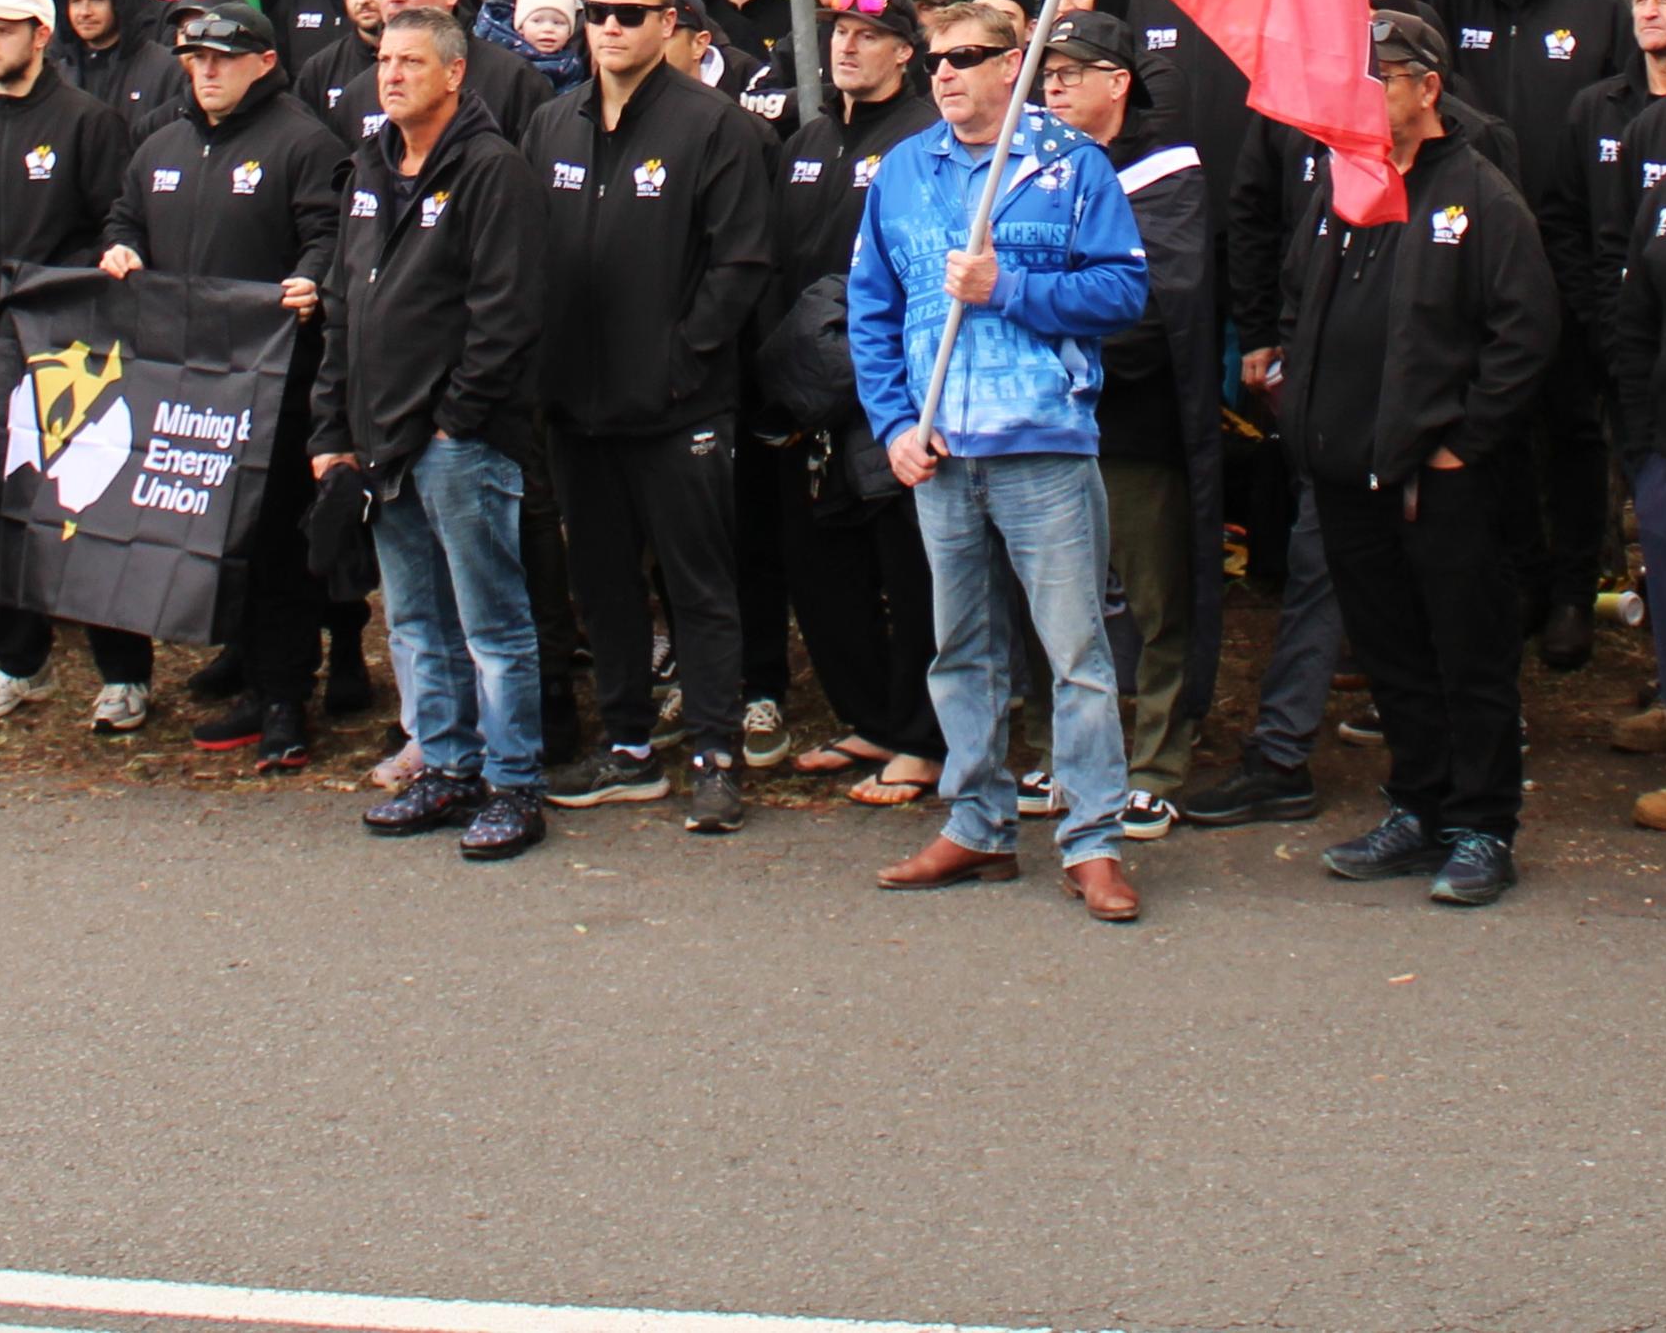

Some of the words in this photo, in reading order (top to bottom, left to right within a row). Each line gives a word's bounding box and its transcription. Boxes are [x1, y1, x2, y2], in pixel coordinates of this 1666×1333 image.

[153, 400, 236, 450] Mining
[236, 408, 252, 442] &
[143, 437, 233, 487] Energy
[131, 472, 210, 516] Union
